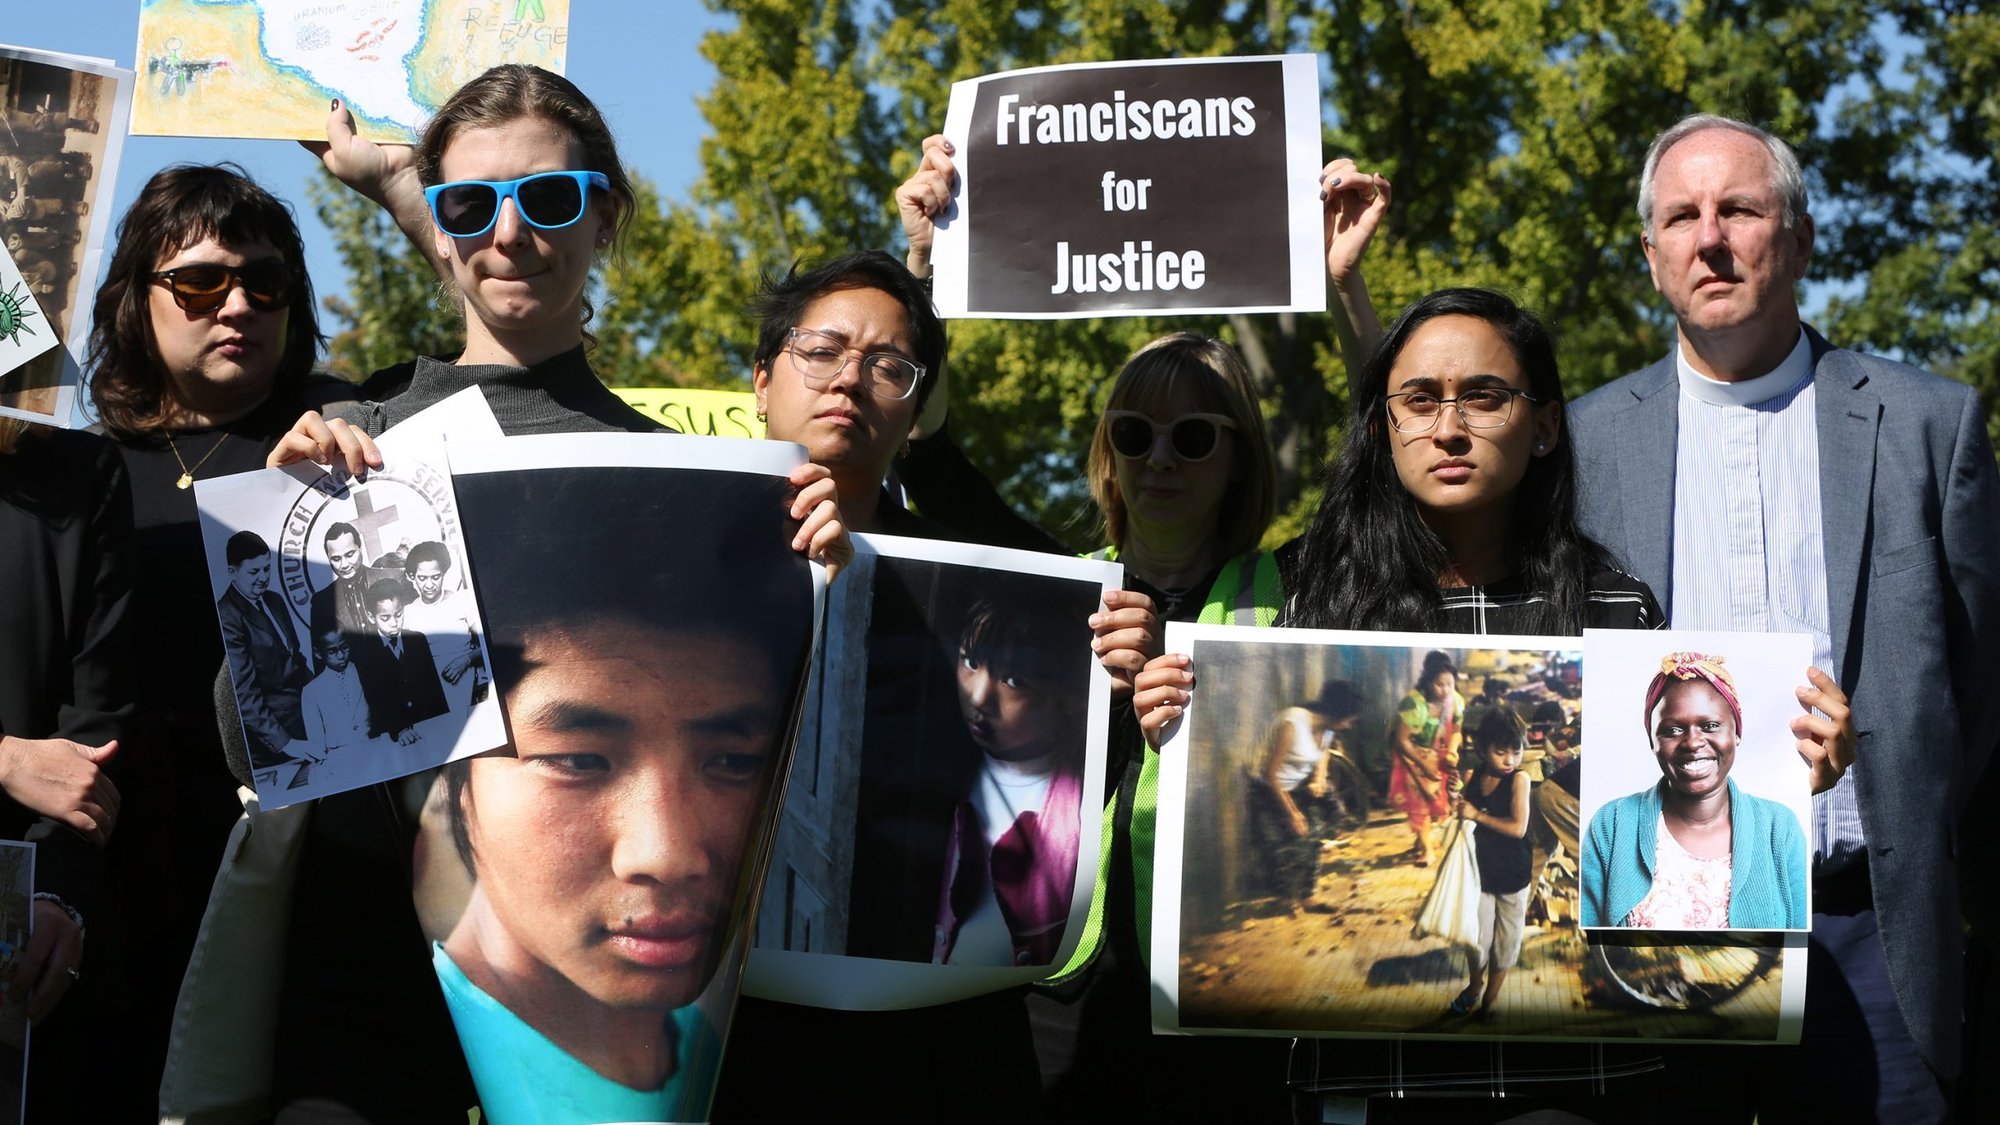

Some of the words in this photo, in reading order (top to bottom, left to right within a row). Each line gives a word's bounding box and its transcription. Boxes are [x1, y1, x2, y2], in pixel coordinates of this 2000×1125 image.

[293, 3, 346, 21] URANIUM
[462, 8, 568, 50] REFUGE
[996, 90, 1257, 146] Franciscans
[1101, 171, 1152, 212] for
[1051, 240, 1206, 295] Justice
[630, 402, 752, 438] SUS
[283, 504, 313, 606] CHURCH
